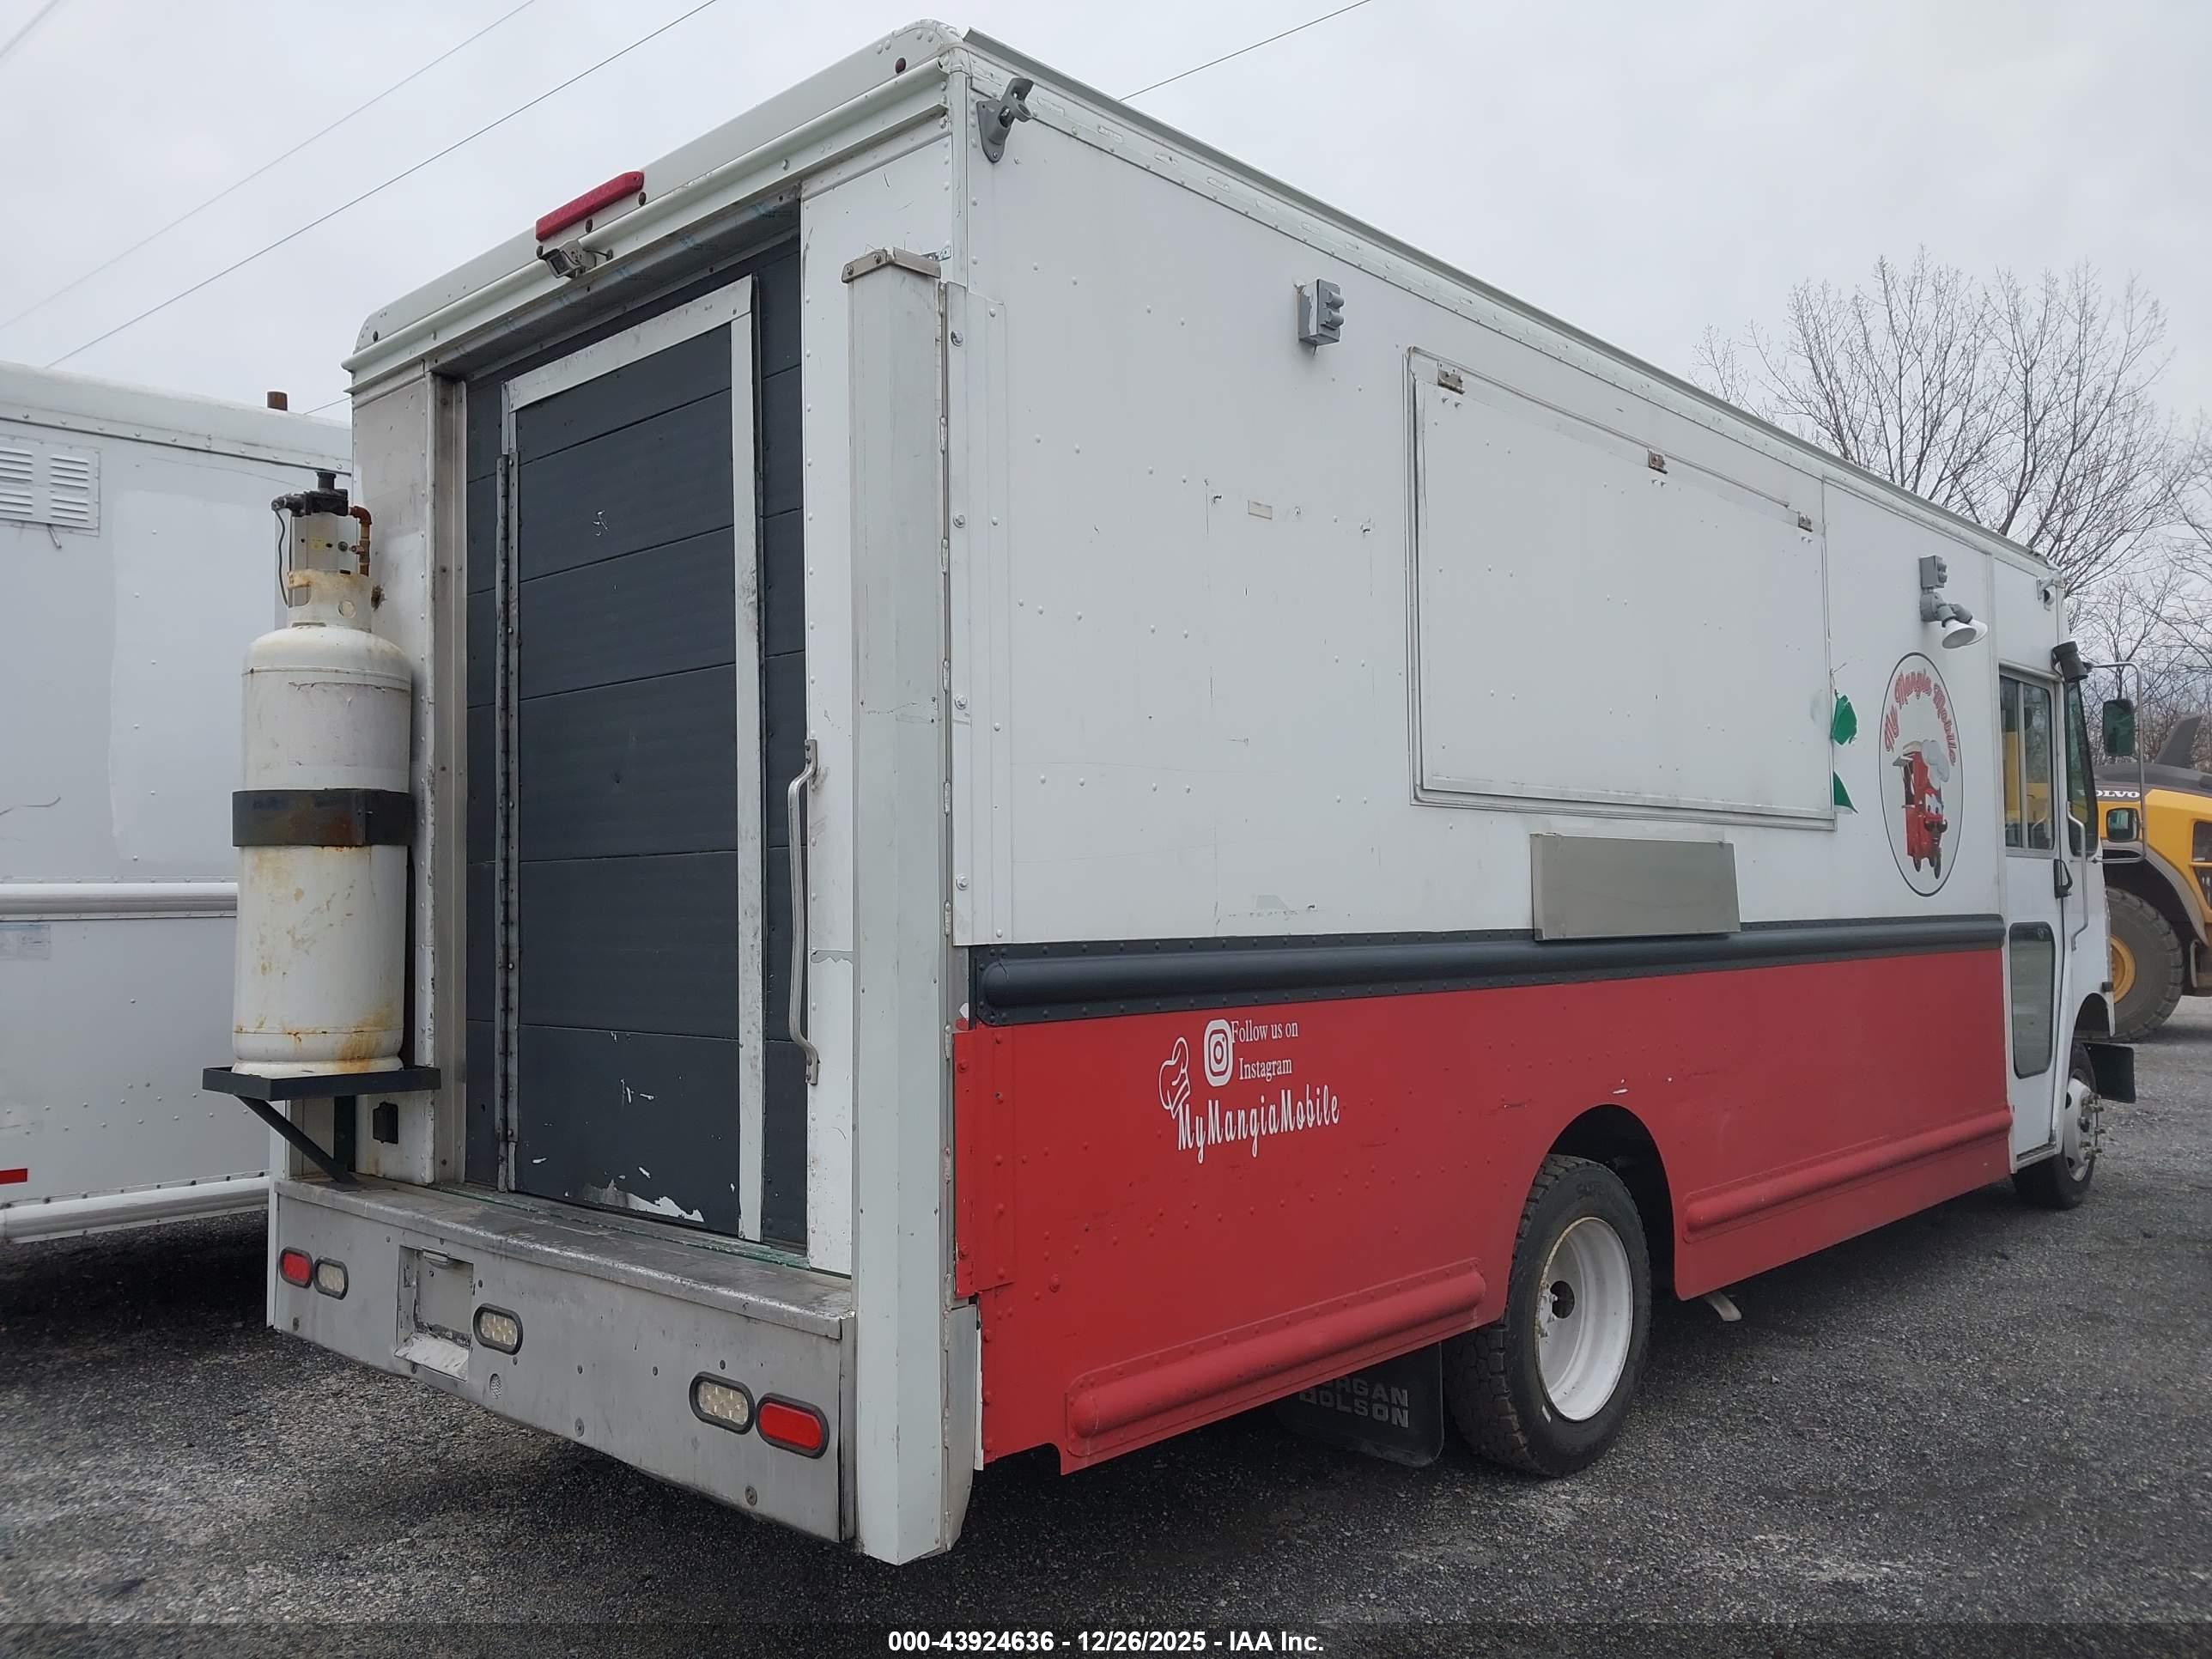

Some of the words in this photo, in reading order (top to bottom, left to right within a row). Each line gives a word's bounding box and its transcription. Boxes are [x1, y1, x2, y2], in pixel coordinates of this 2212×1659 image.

[1231, 1019, 1268, 1043] Follow
[1271, 1024, 1283, 1039] us
[1285, 1022, 1299, 1038] on
[1239, 1057, 1292, 1082] Instagram
[1177, 1083, 1340, 1164] MyMangiaMobile
[1325, 1376, 1408, 1407] RGAN
